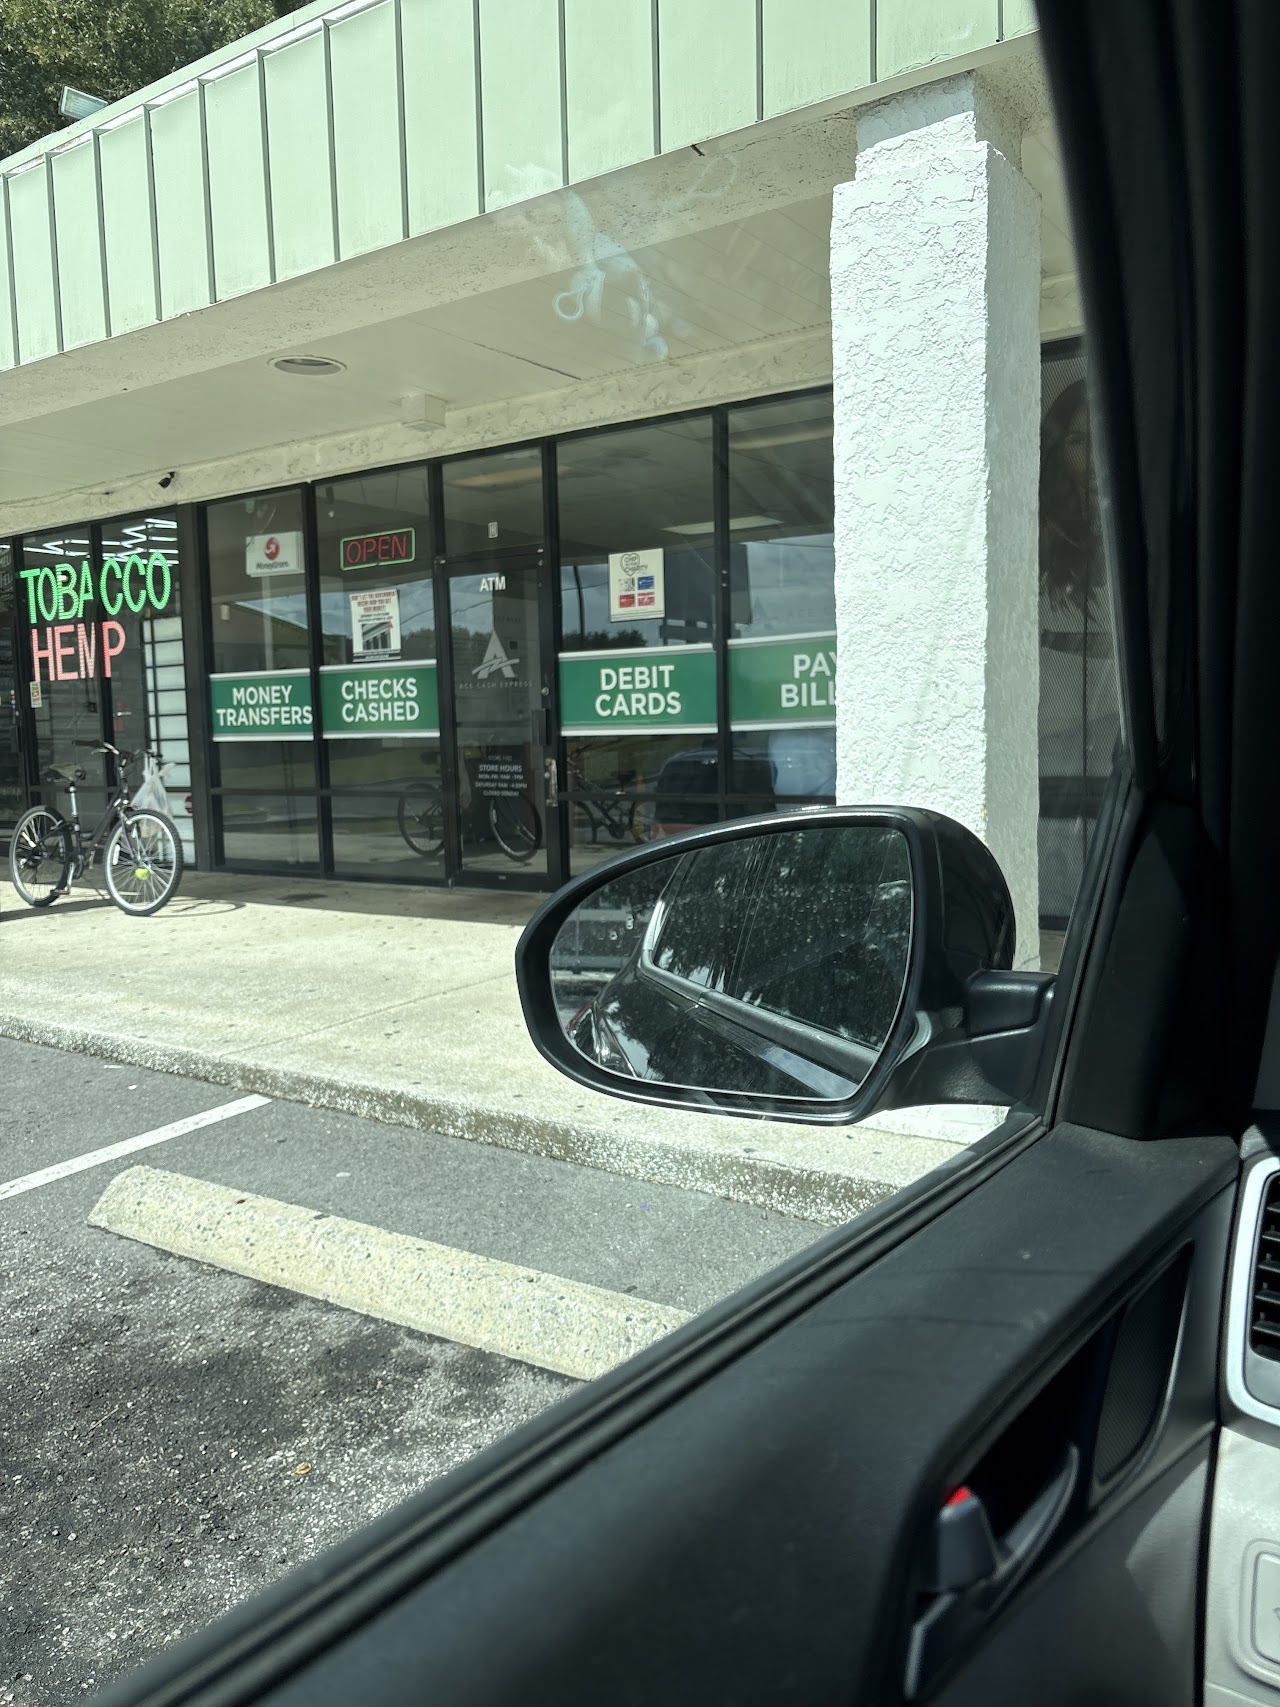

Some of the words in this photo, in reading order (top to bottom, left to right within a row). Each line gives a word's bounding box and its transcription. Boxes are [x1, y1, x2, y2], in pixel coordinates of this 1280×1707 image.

[345, 534, 407, 564] OPEN
[19, 552, 171, 624] TOBACCO
[480, 576, 506, 592] ATM
[31, 620, 126, 682] HEMP
[341, 677, 418, 700] CHECKS
[600, 665, 675, 691] DEBIT
[232, 685, 292, 706] MONEY
[595, 691, 682, 717] CARDS
[216, 706, 313, 727] TRANSFERS
[341, 701, 420, 723] CASHED
[500, 764, 522, 773] HOURS
